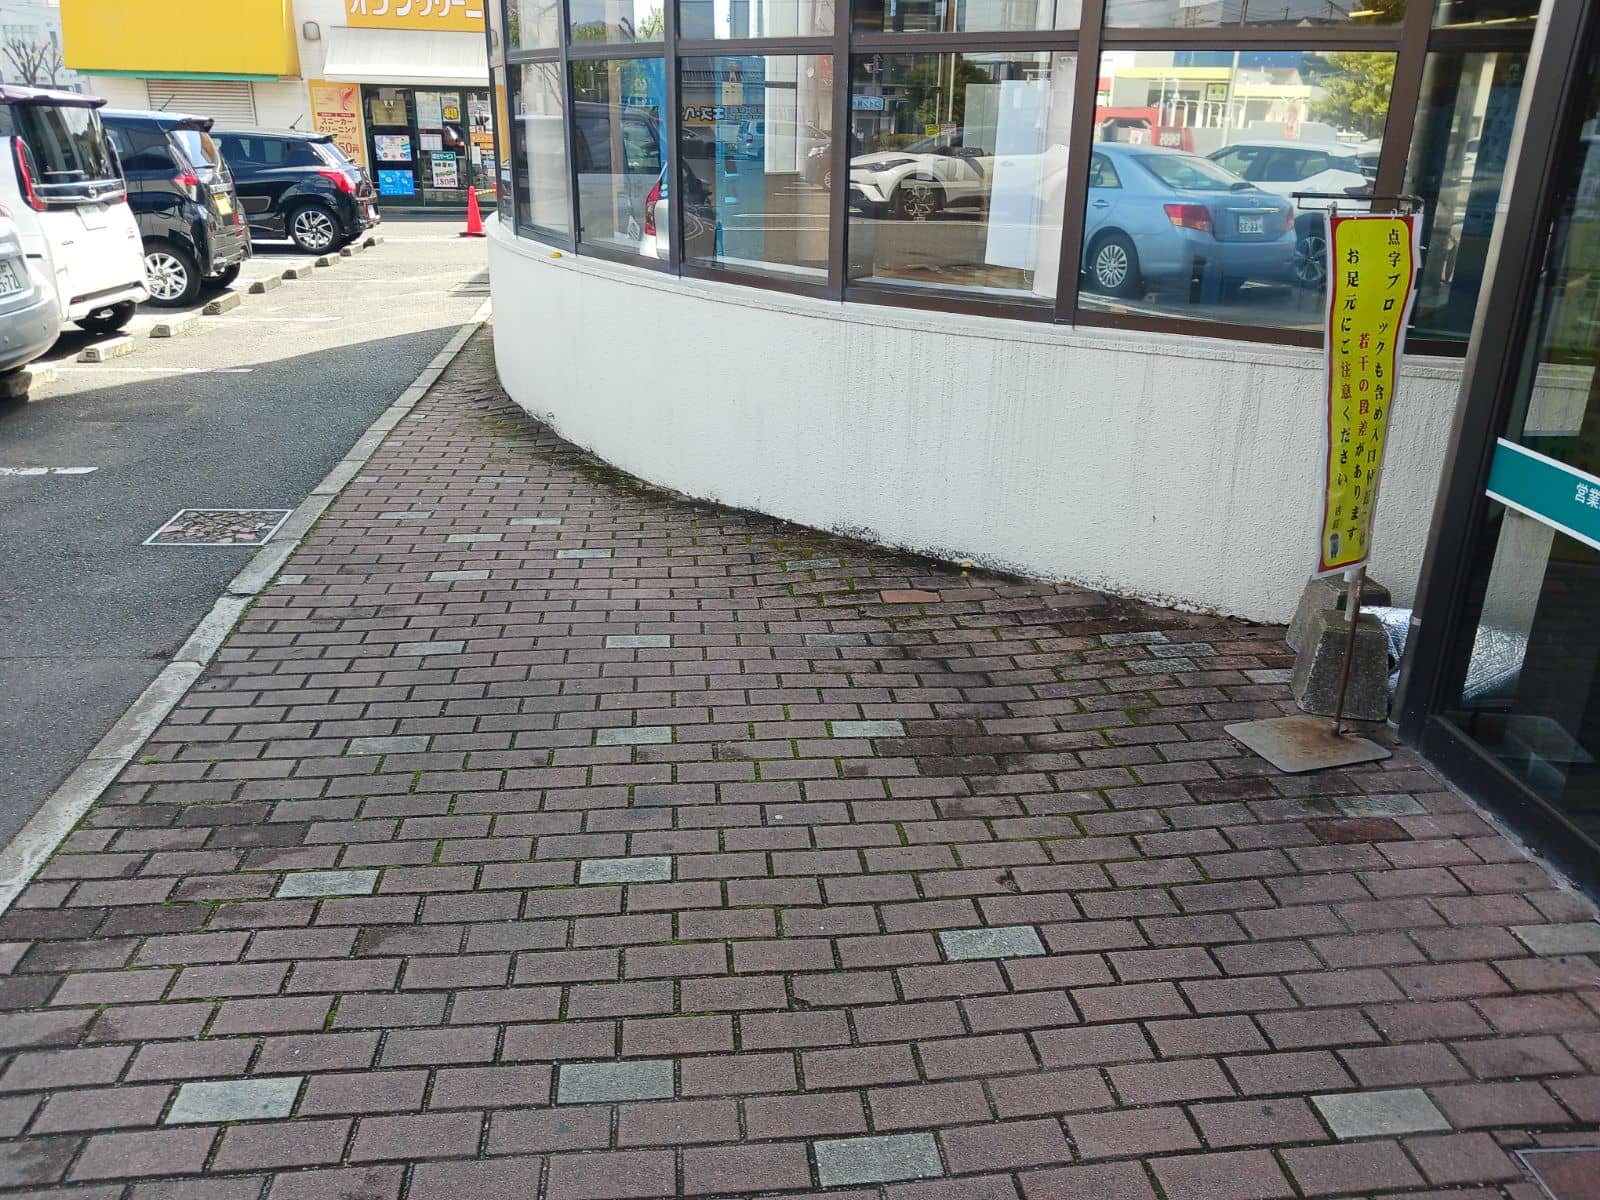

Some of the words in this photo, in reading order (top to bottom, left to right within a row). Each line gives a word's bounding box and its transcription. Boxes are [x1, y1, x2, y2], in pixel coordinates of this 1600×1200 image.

[1337, 247, 1360, 487] お足元にご注意ください
[1347, 332, 1370, 541] 若干の段差があります
[1575, 482, 1600, 510] 営業
